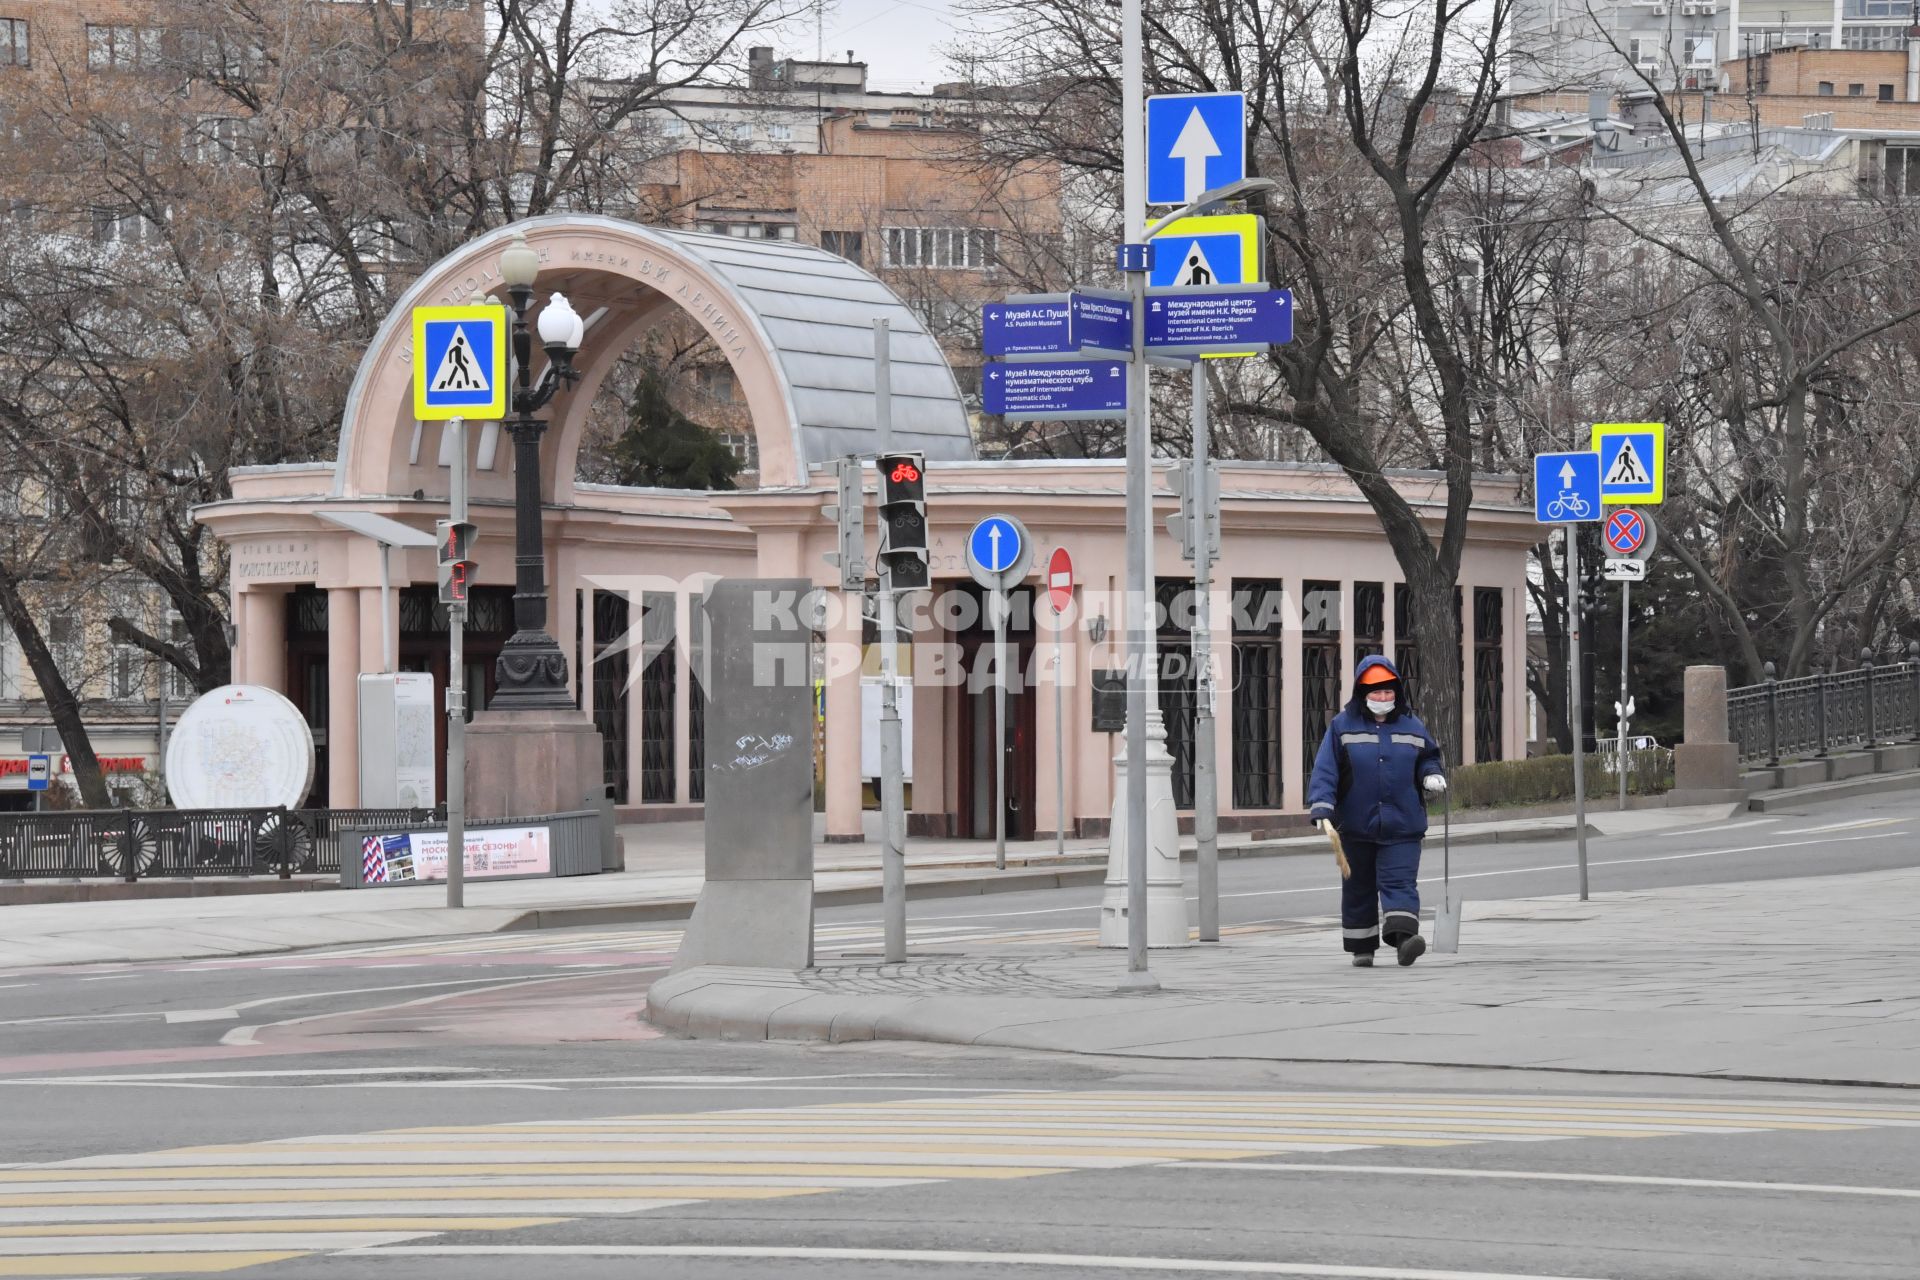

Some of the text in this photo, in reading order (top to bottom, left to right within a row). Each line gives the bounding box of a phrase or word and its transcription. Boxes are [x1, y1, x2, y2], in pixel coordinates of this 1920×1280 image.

[571, 251, 630, 268] ИМЕНИ
[677, 280, 746, 360] ЛЕНИНА
[1167, 299, 1256, 309] Международный центр-
[1005, 311, 1030, 321] Музей
[1046, 310, 1070, 320] Пушк
[1168, 309, 1190, 318] музей
[1191, 308, 1215, 316] имени
[1231, 307, 1256, 316] Рериха
[1015, 320, 1037, 328] Pushkin
[1005, 369, 1090, 380] Музей Международного
[1005, 375, 1093, 386] нумизматического клуба
[1037, 385, 1074, 393] International
[1005, 394, 1038, 402] numismatic
[421, 842, 517, 854] МОСККИЕ СЕЗОНЫ
